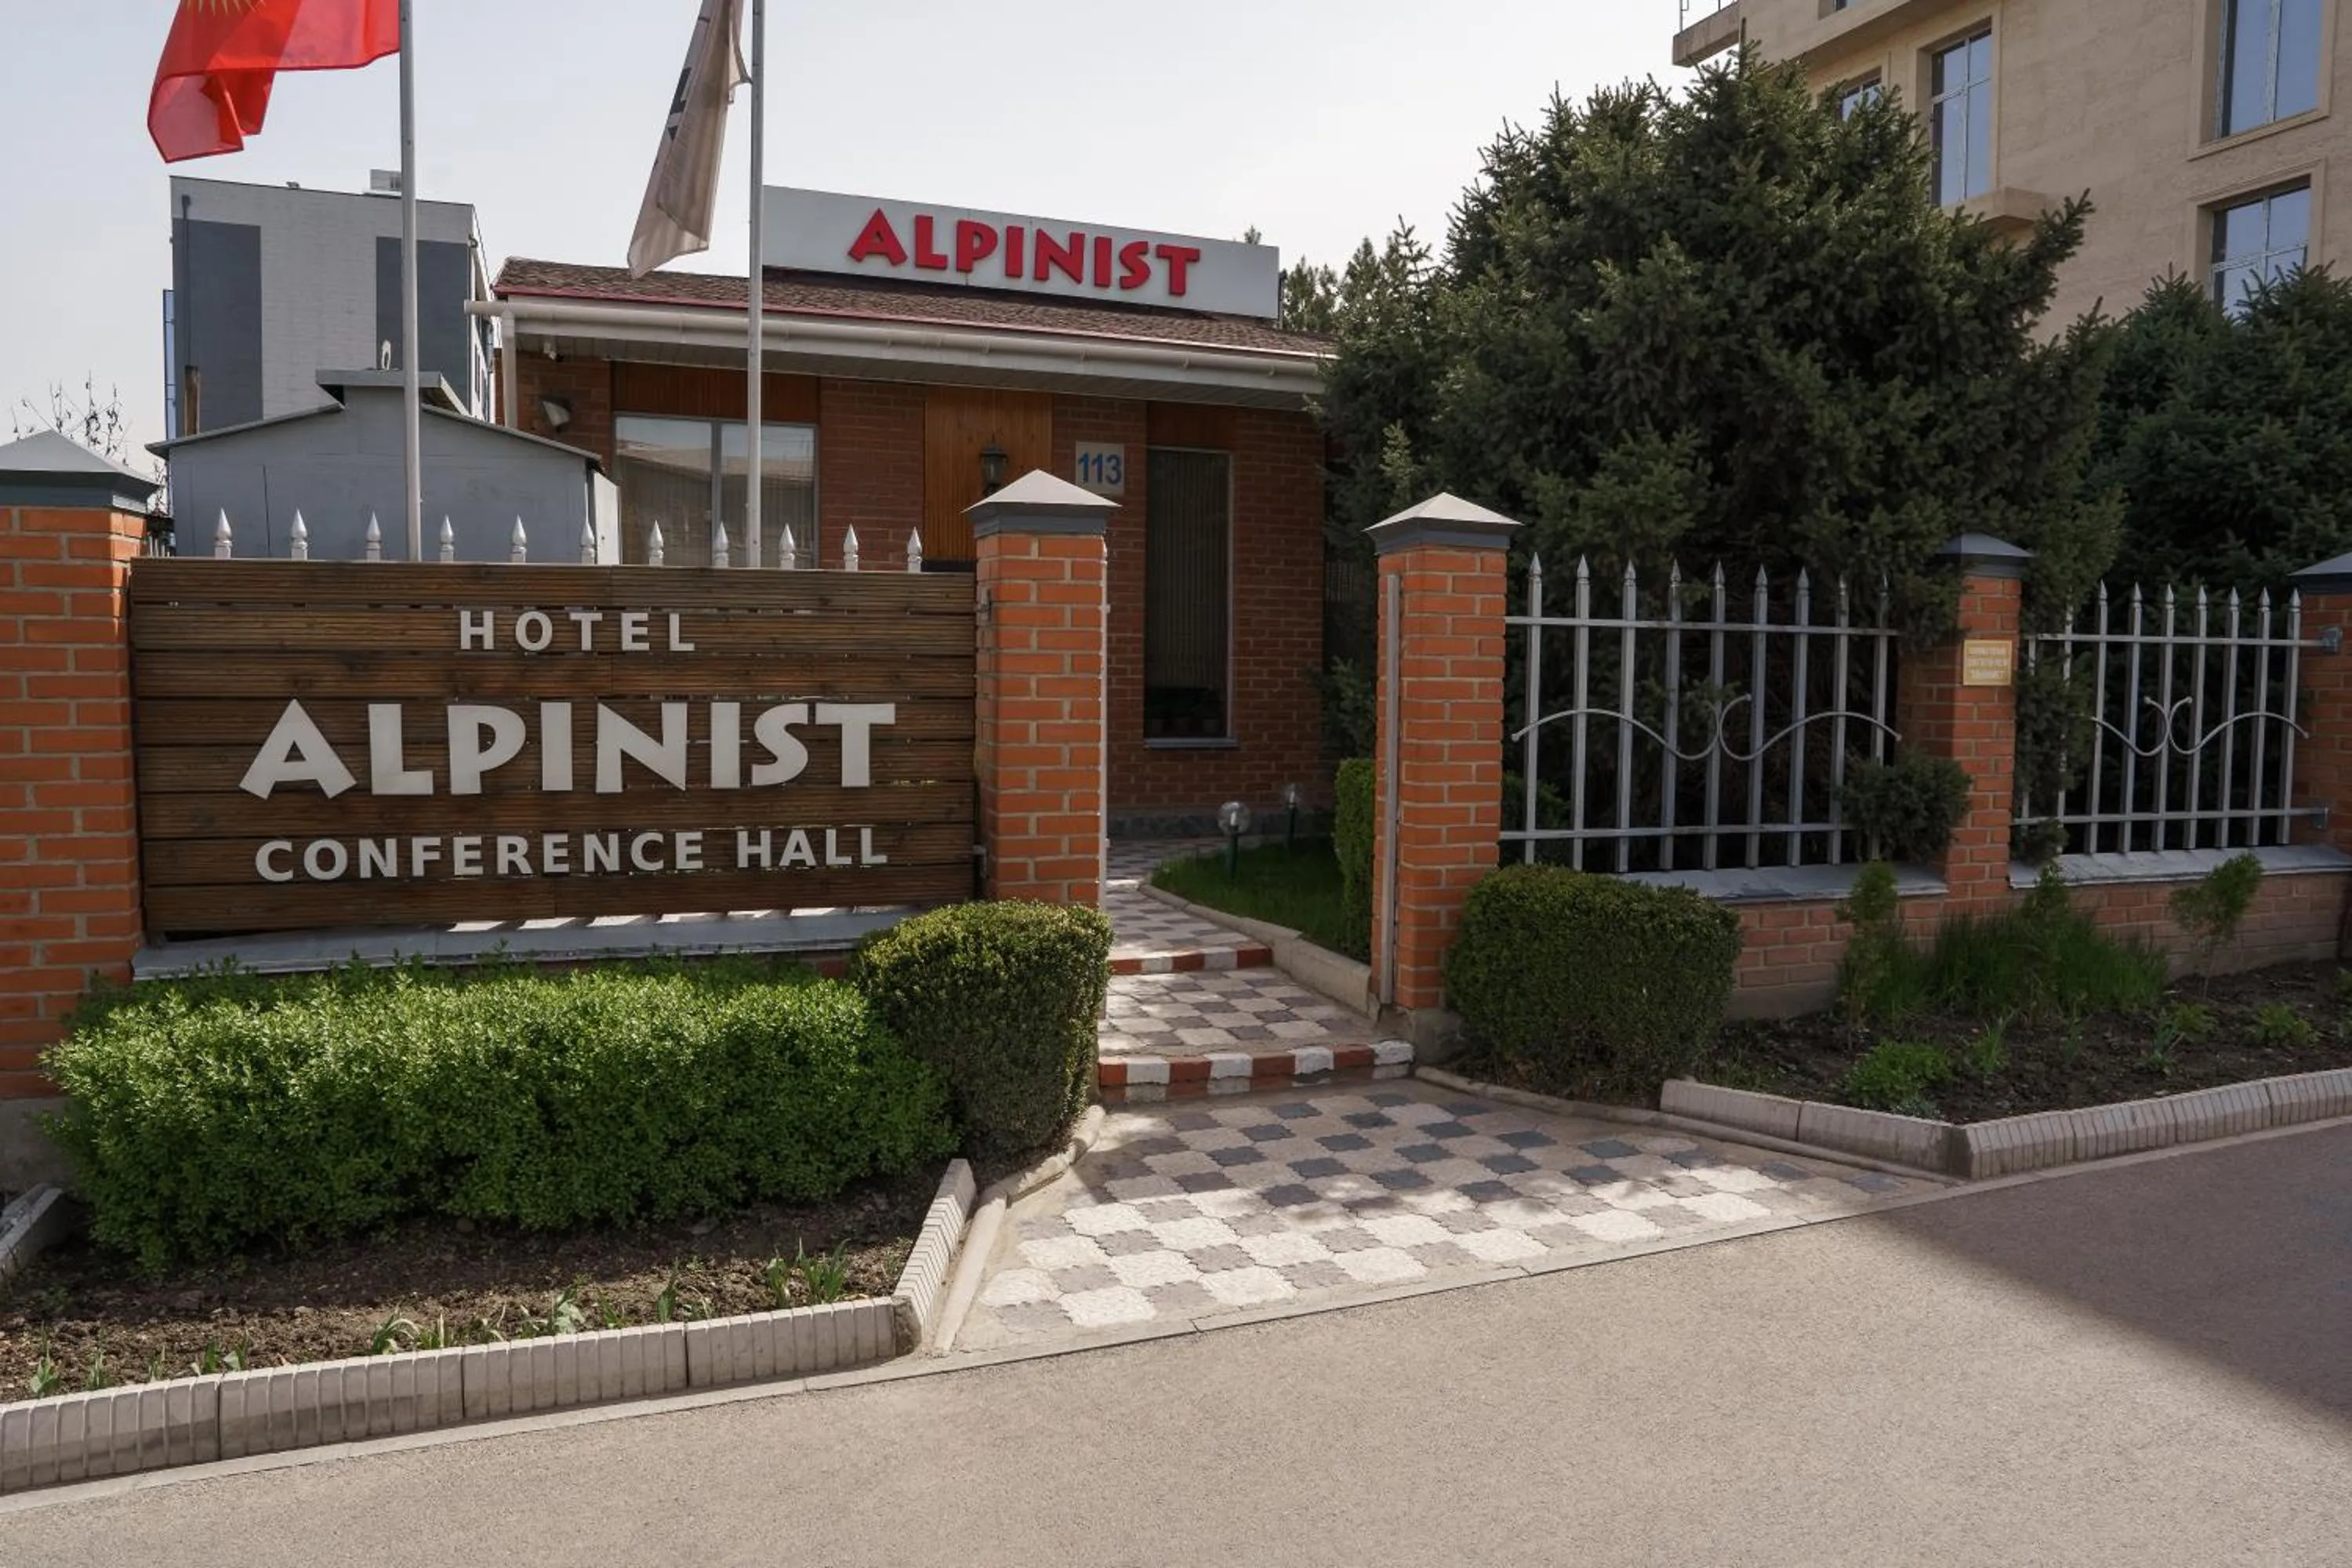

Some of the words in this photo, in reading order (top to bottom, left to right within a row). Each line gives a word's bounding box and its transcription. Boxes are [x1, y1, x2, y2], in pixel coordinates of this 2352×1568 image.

[847, 208, 1200, 296] ALPINIST
[1078, 451, 1122, 485] 113
[459, 610, 695, 652] HOTEL
[238, 698, 896, 800] ALPINIST
[255, 831, 703, 882] CONFERENCE
[736, 828, 887, 868] HALL
